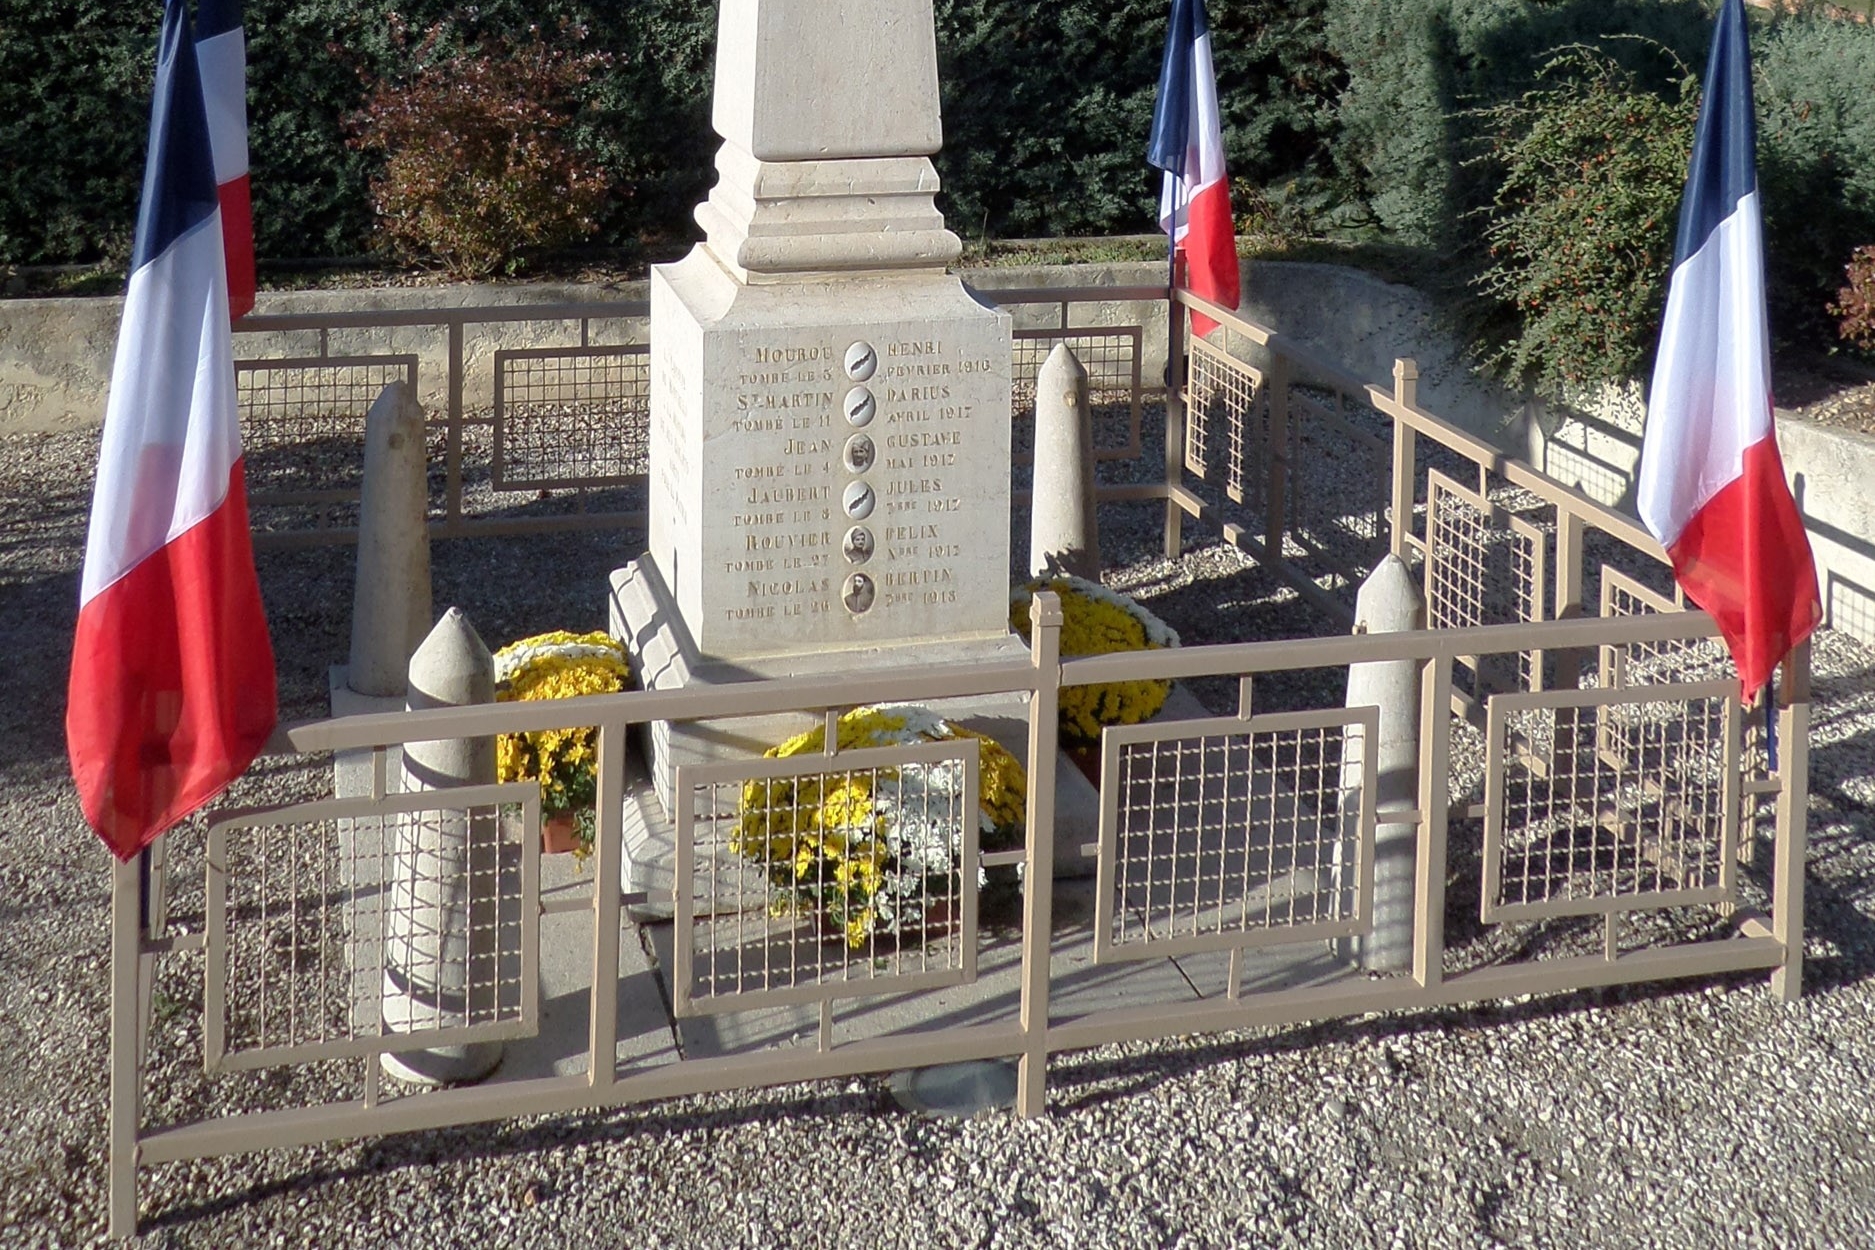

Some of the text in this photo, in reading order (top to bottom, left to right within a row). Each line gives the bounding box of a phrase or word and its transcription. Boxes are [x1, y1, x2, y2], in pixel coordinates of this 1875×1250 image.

[755, 341, 942, 363] MOUROU HENRI
[798, 371, 815, 382] LE
[887, 386, 951, 402] DARIUS
[793, 417, 810, 429] LE
[819, 415, 831, 427] 11
[887, 410, 930, 424] AVRIL
[940, 406, 972, 420] 1917
[784, 431, 961, 455] JEAN GUSTAVE
[794, 464, 811, 476] LE
[886, 457, 914, 470] MAI
[748, 478, 942, 504] JAUBERT JULES
[793, 510, 811, 523] LE
[746, 531, 831, 551] ROUVIER
[747, 578, 830, 597] NICOLAS
[784, 604, 801, 616] LE
